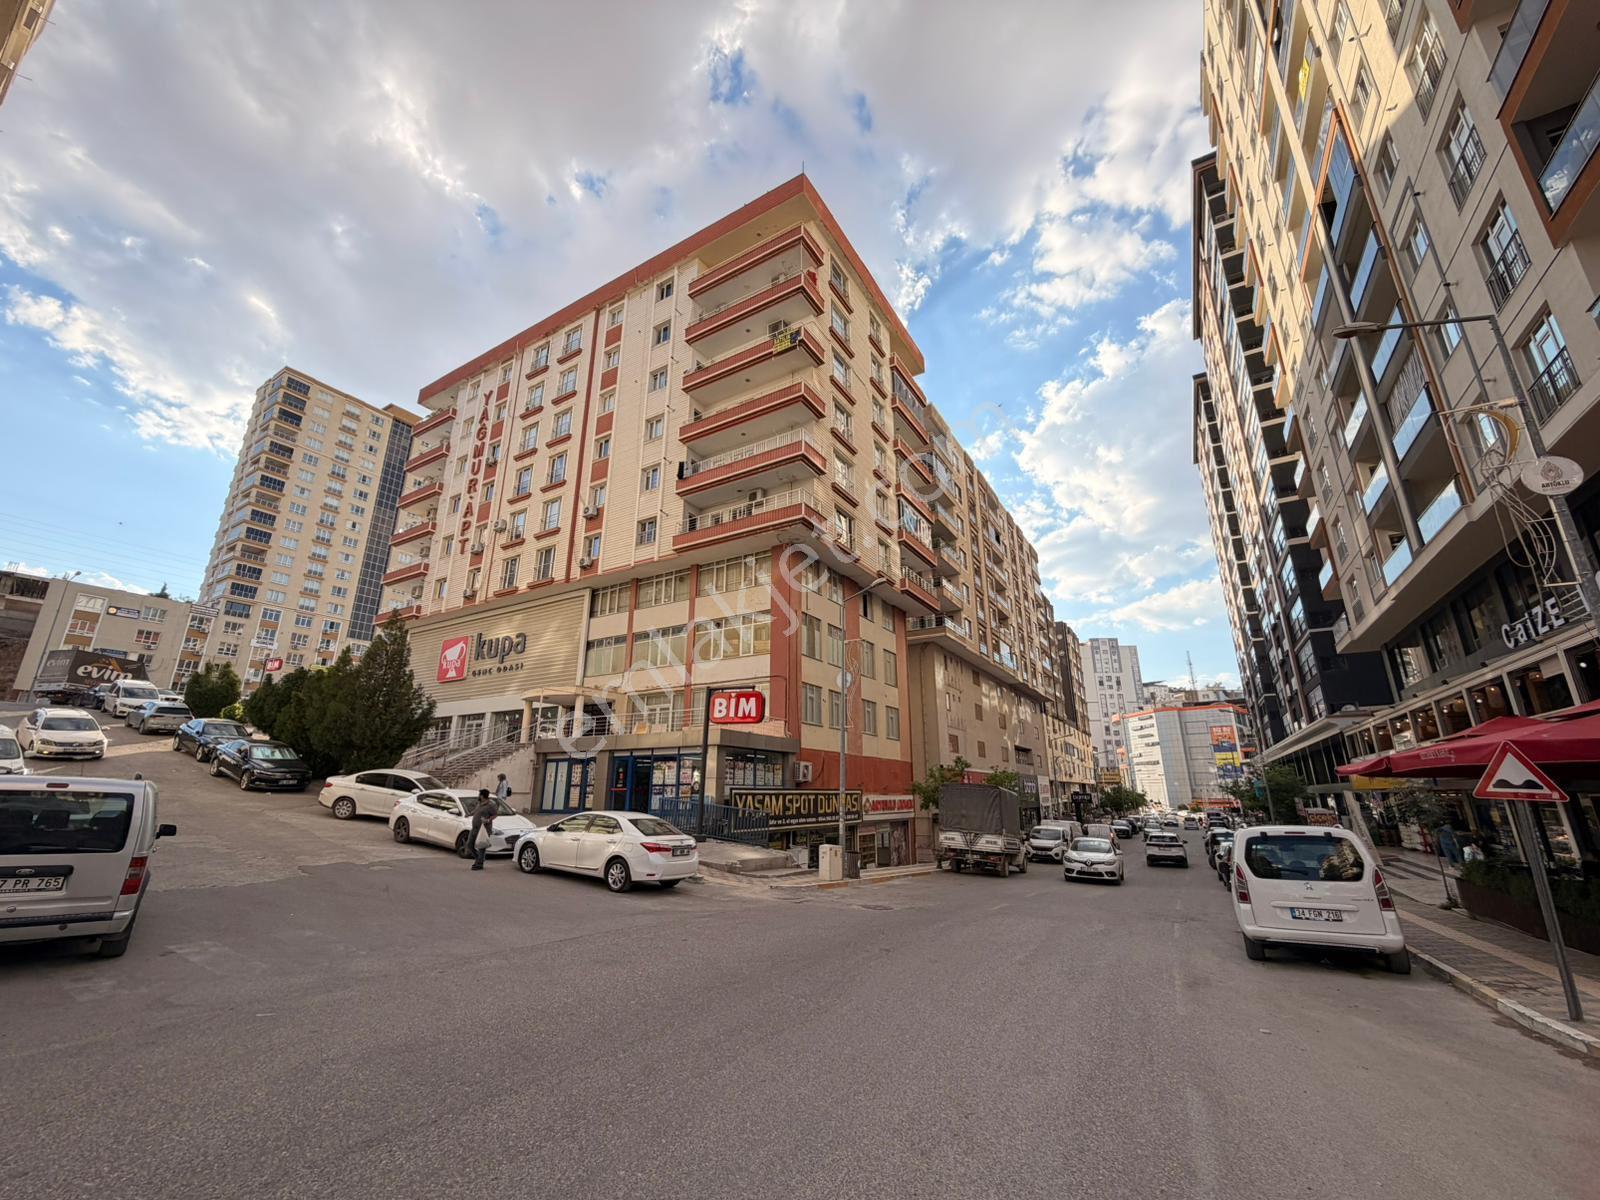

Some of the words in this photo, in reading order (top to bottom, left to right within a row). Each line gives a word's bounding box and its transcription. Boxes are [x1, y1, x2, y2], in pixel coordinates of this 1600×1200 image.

[458, 502, 473, 555] APT
[474, 632, 527, 664] kupa
[76, 664, 133, 681] evim
[713, 692, 756, 718] BİM
[785, 794, 816, 815] SPOT
[818, 794, 861, 813] DÜNASI
[13, 880, 30, 888] PR
[38, 878, 61, 888] 765
[1296, 909, 1306, 917] 34
